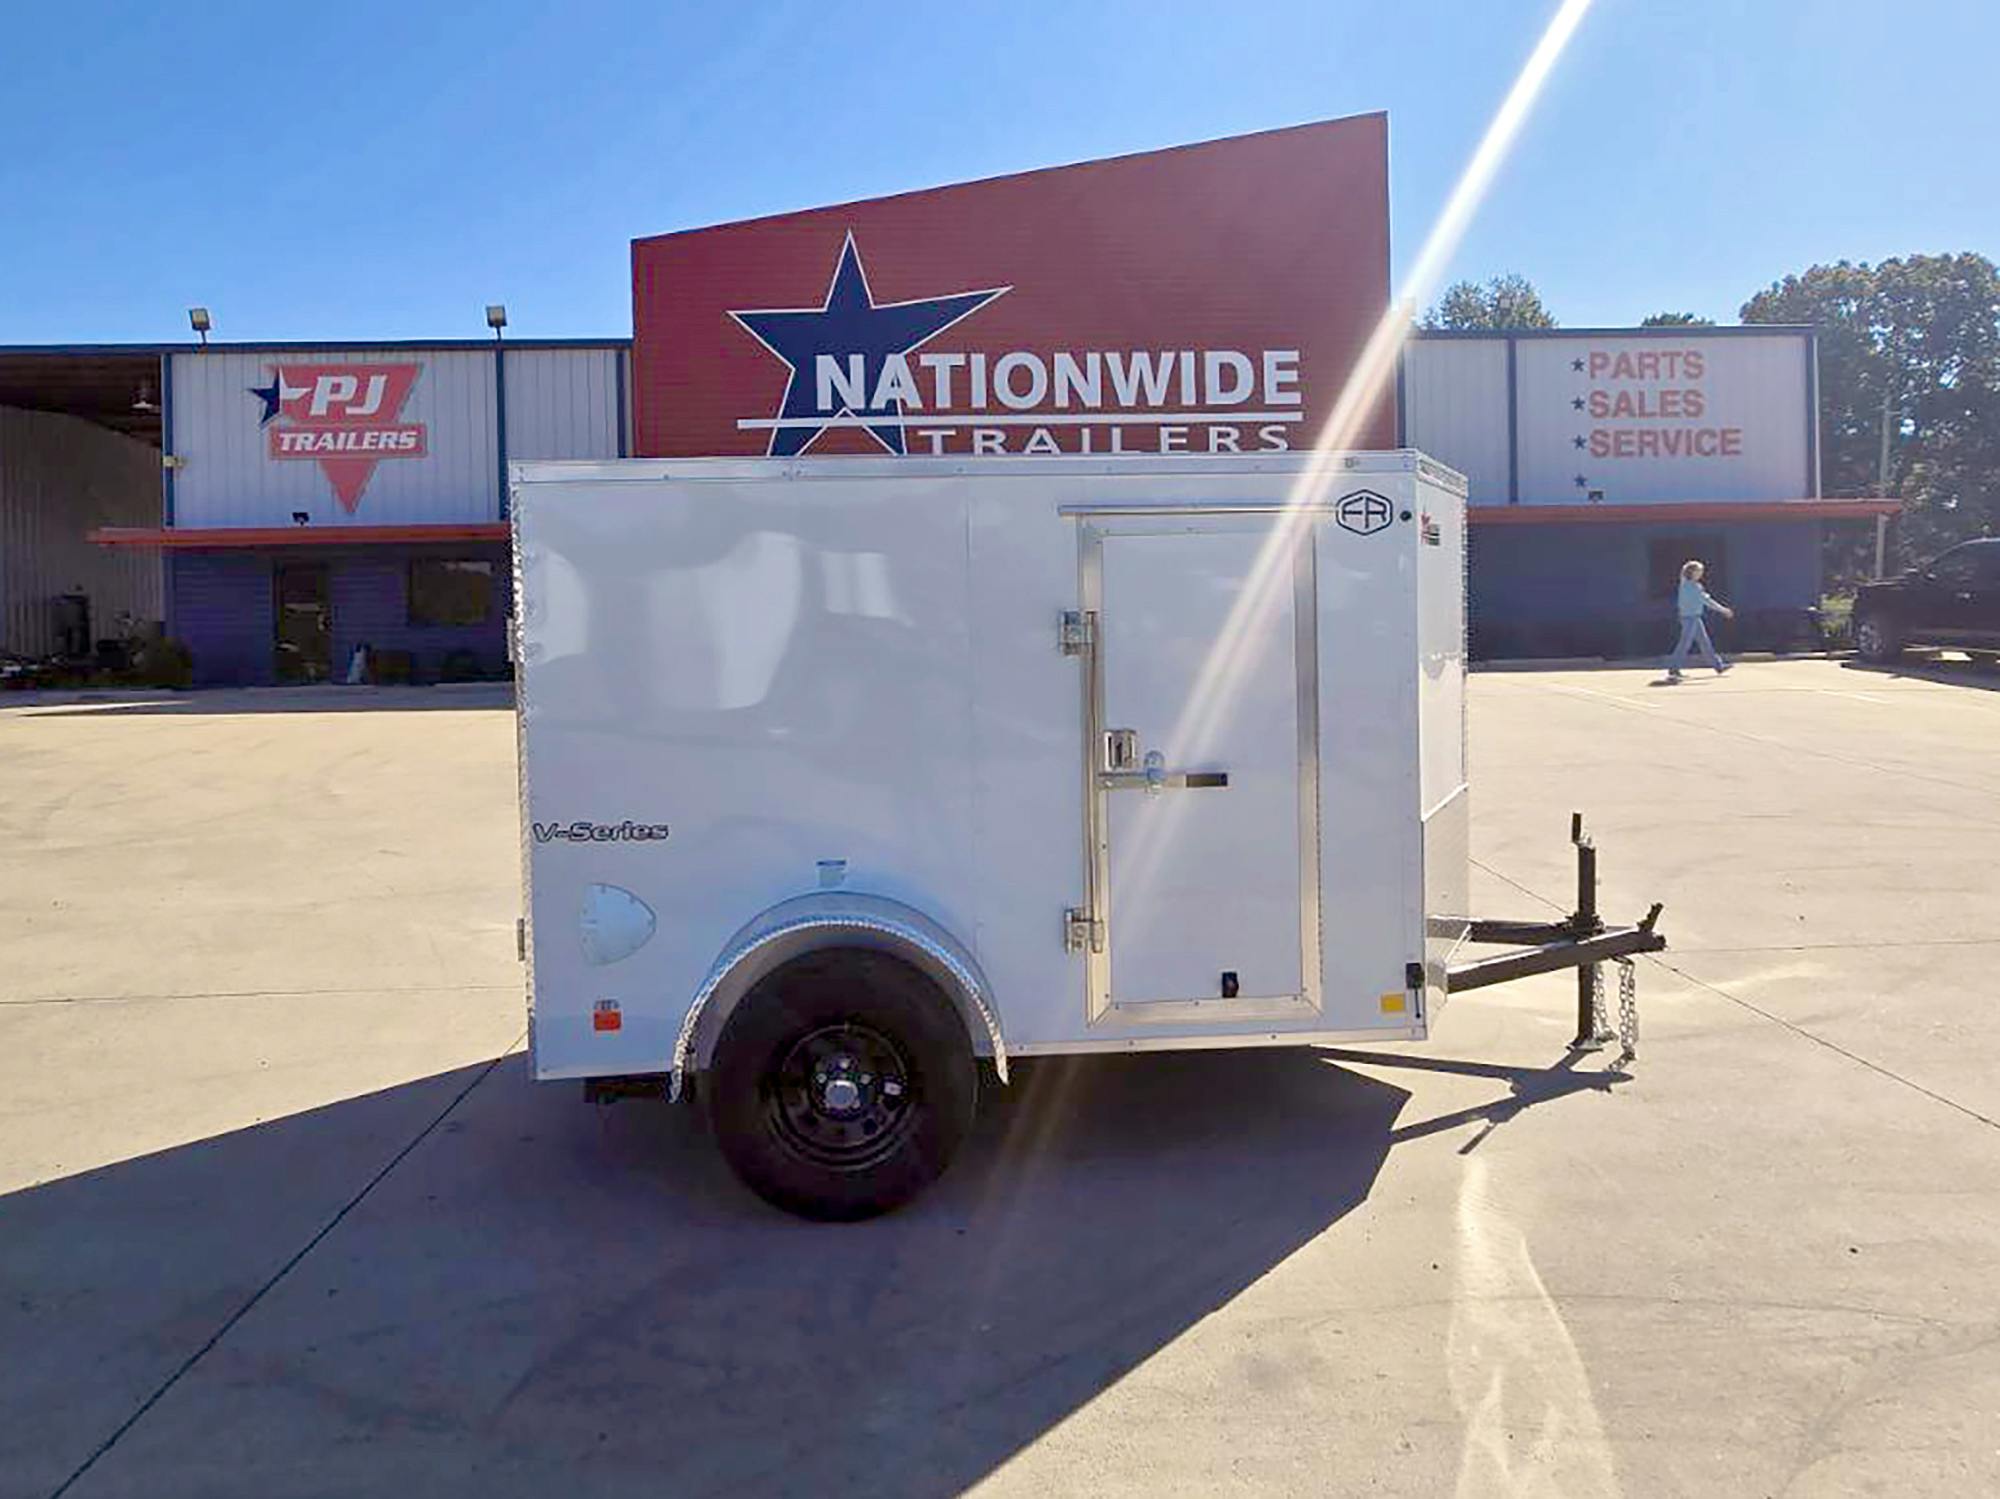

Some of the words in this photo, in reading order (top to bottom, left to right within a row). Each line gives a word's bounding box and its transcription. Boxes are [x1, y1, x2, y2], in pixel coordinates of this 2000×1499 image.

[1589, 352, 1704, 379] PARTS
[816, 351, 1301, 410] NATIONWIDE
[310, 375, 388, 416] PJ
[1589, 389, 1704, 418] SALES
[279, 431, 418, 451] TRAILERS
[919, 425, 1289, 456] TRAILERS
[1589, 428, 1742, 458] SERVICE
[532, 820, 669, 843] V-Series
